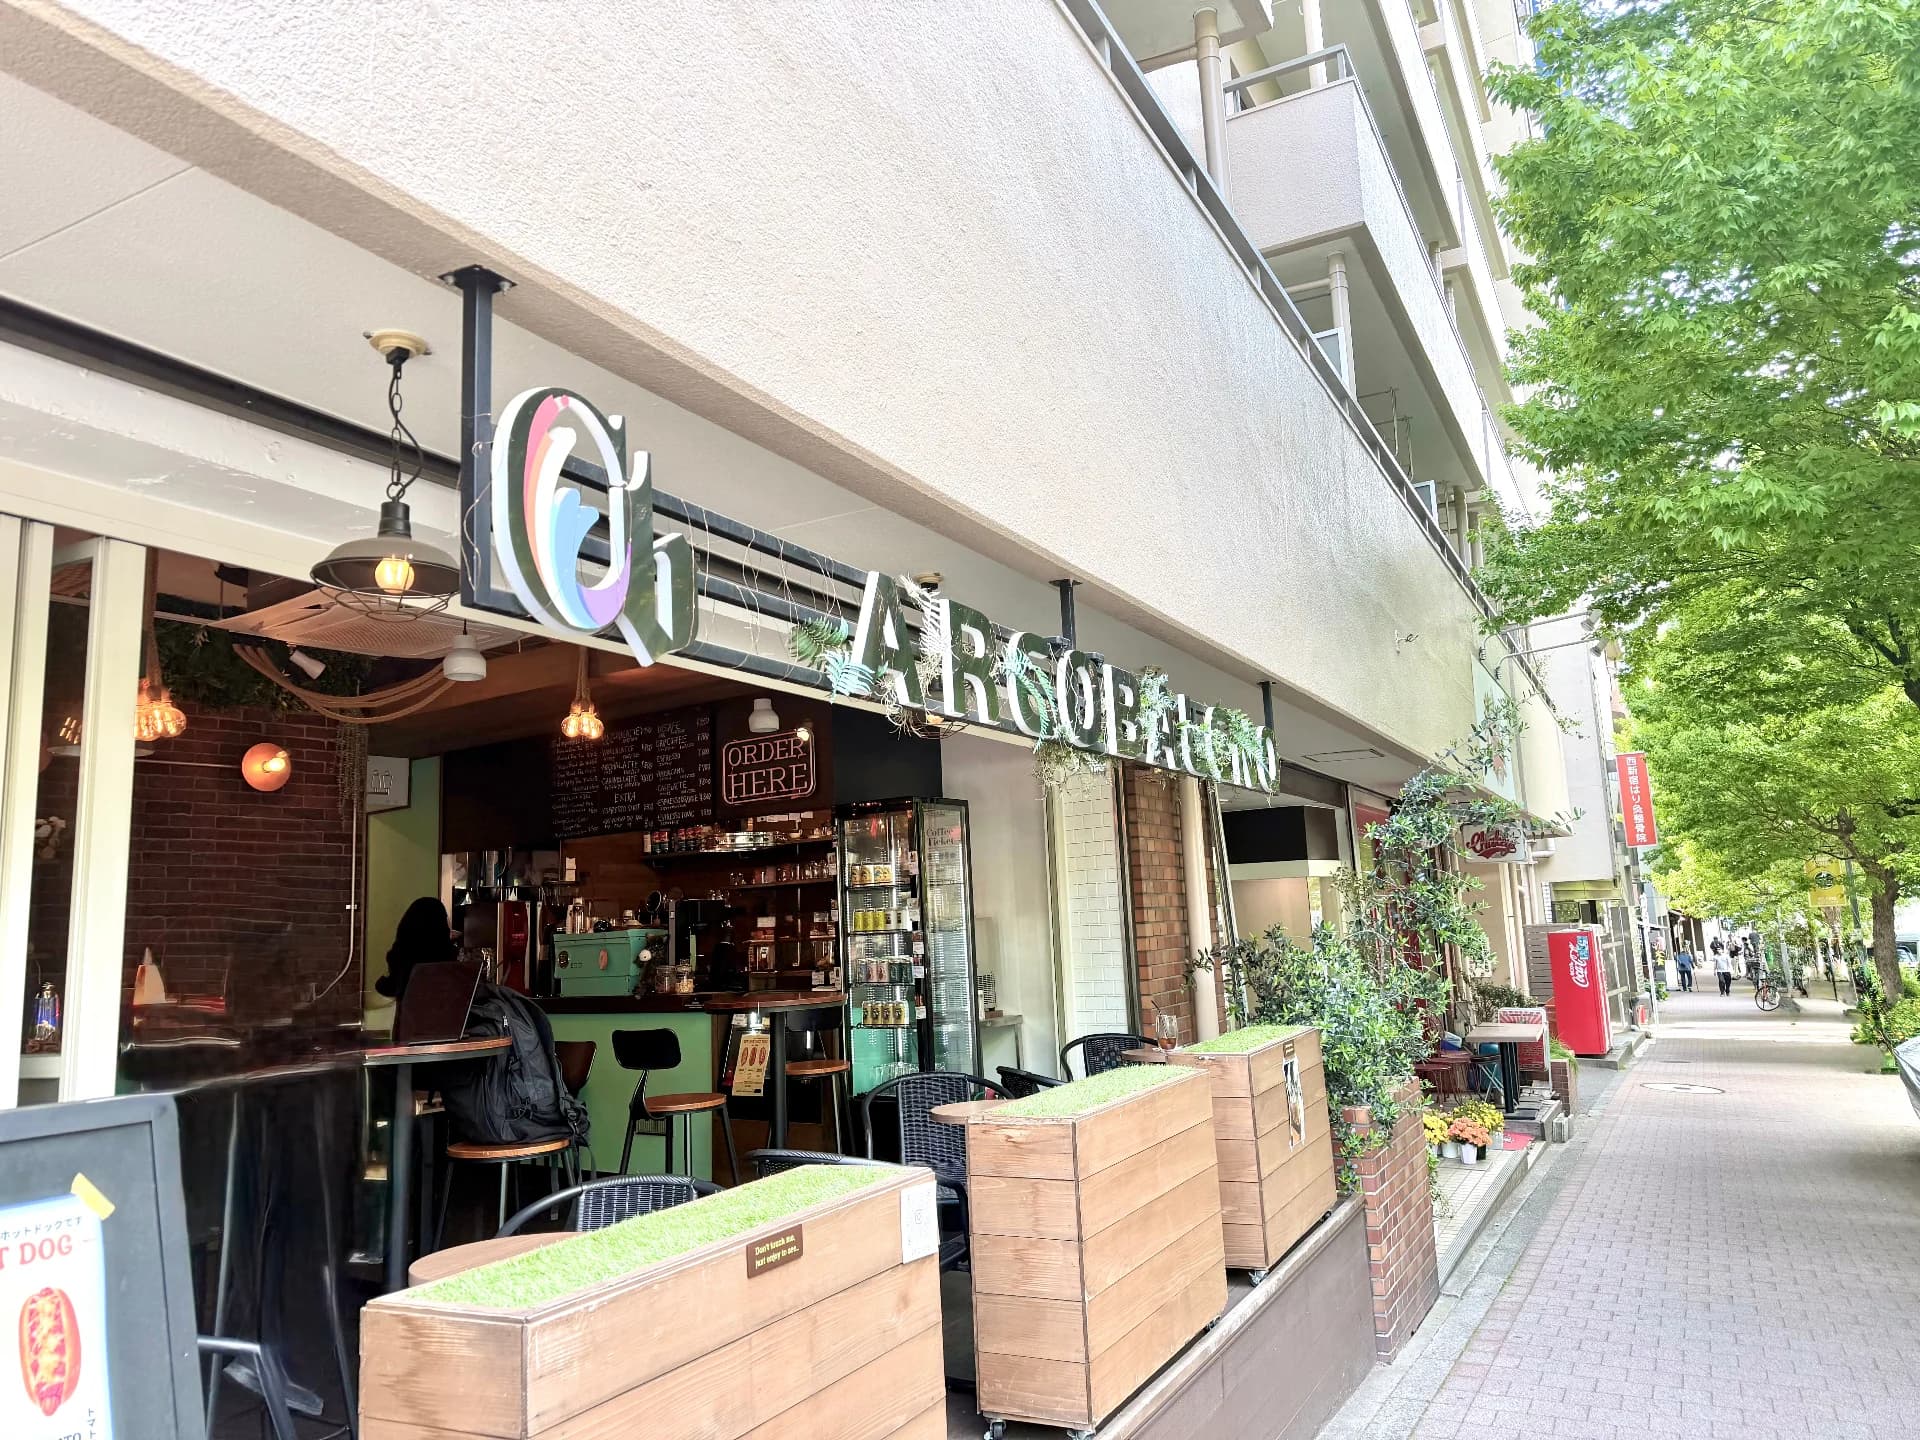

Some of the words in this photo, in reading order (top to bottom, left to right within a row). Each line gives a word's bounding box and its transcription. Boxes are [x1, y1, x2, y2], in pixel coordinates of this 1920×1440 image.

[728, 737, 807, 767] ORDER
[728, 763, 808, 799] HERE
[1626, 757, 1647, 843] 西新宿はり灸整骨院
[926, 827, 954, 838] Coffee
[928, 837, 955, 847] Ticket
[1569, 941, 1589, 988] Coca-C
[19, 1234, 73, 1265] DOG
[755, 1244, 770, 1256] Don't
[770, 1237, 785, 1250] touch
[755, 1256, 766, 1270] just
[766, 1250, 781, 1263] enjoy
[781, 1249, 788, 1257] to
